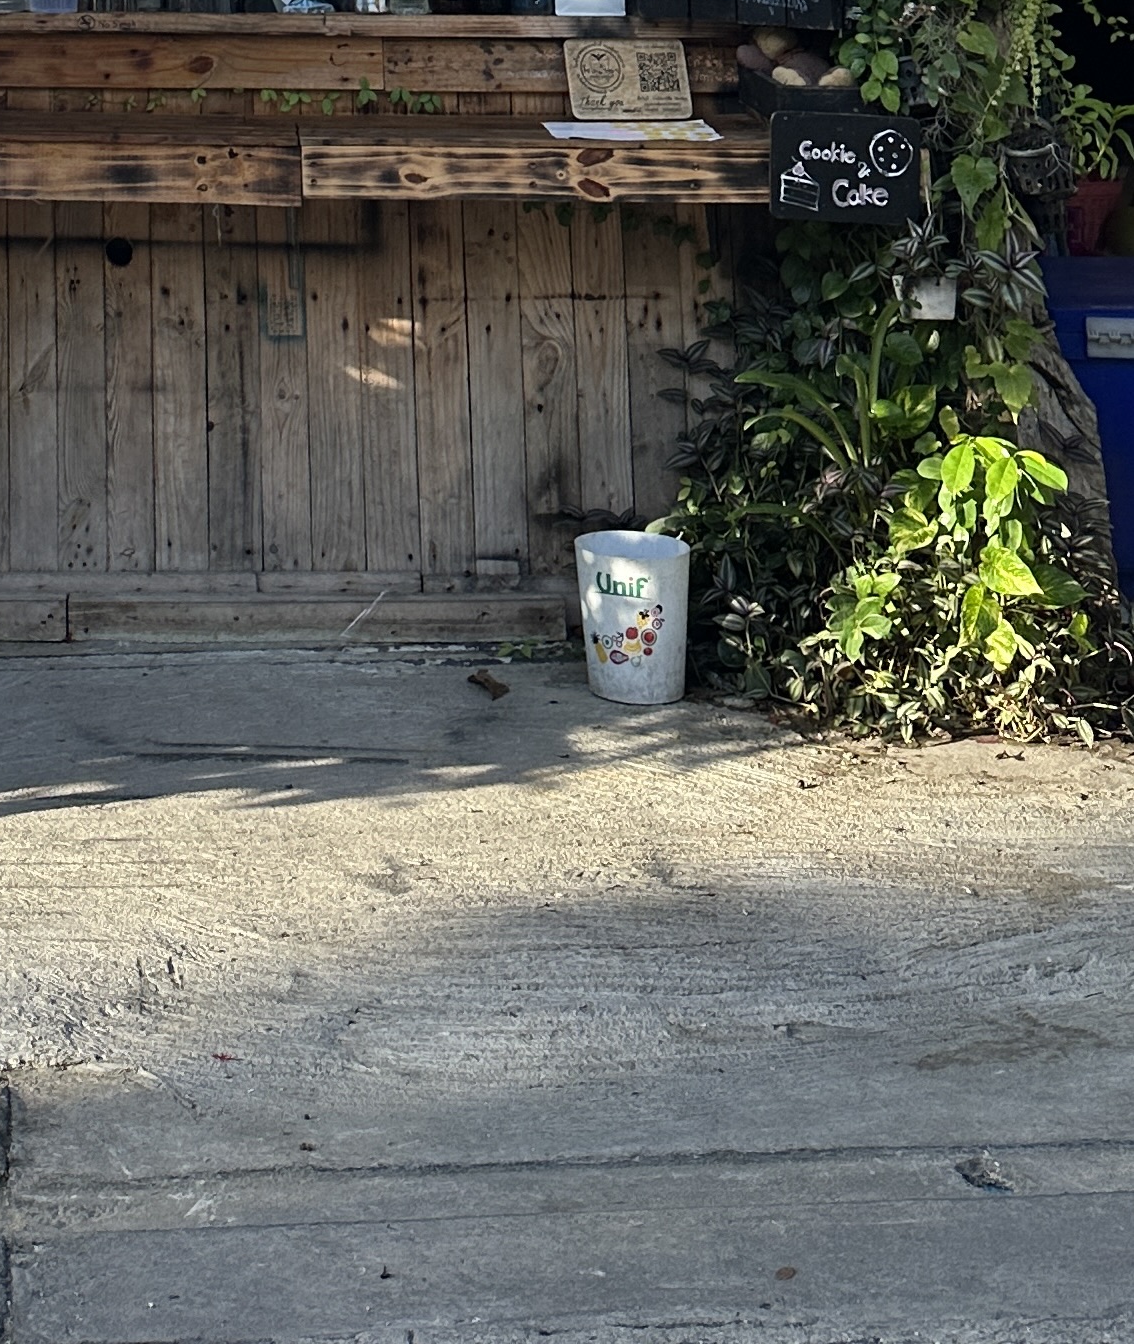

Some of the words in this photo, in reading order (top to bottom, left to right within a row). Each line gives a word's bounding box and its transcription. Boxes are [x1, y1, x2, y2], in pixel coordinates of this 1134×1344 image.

[799, 140, 857, 164] Cookie
[832, 178, 890, 208] Cake
[596, 571, 650, 599] Unif
